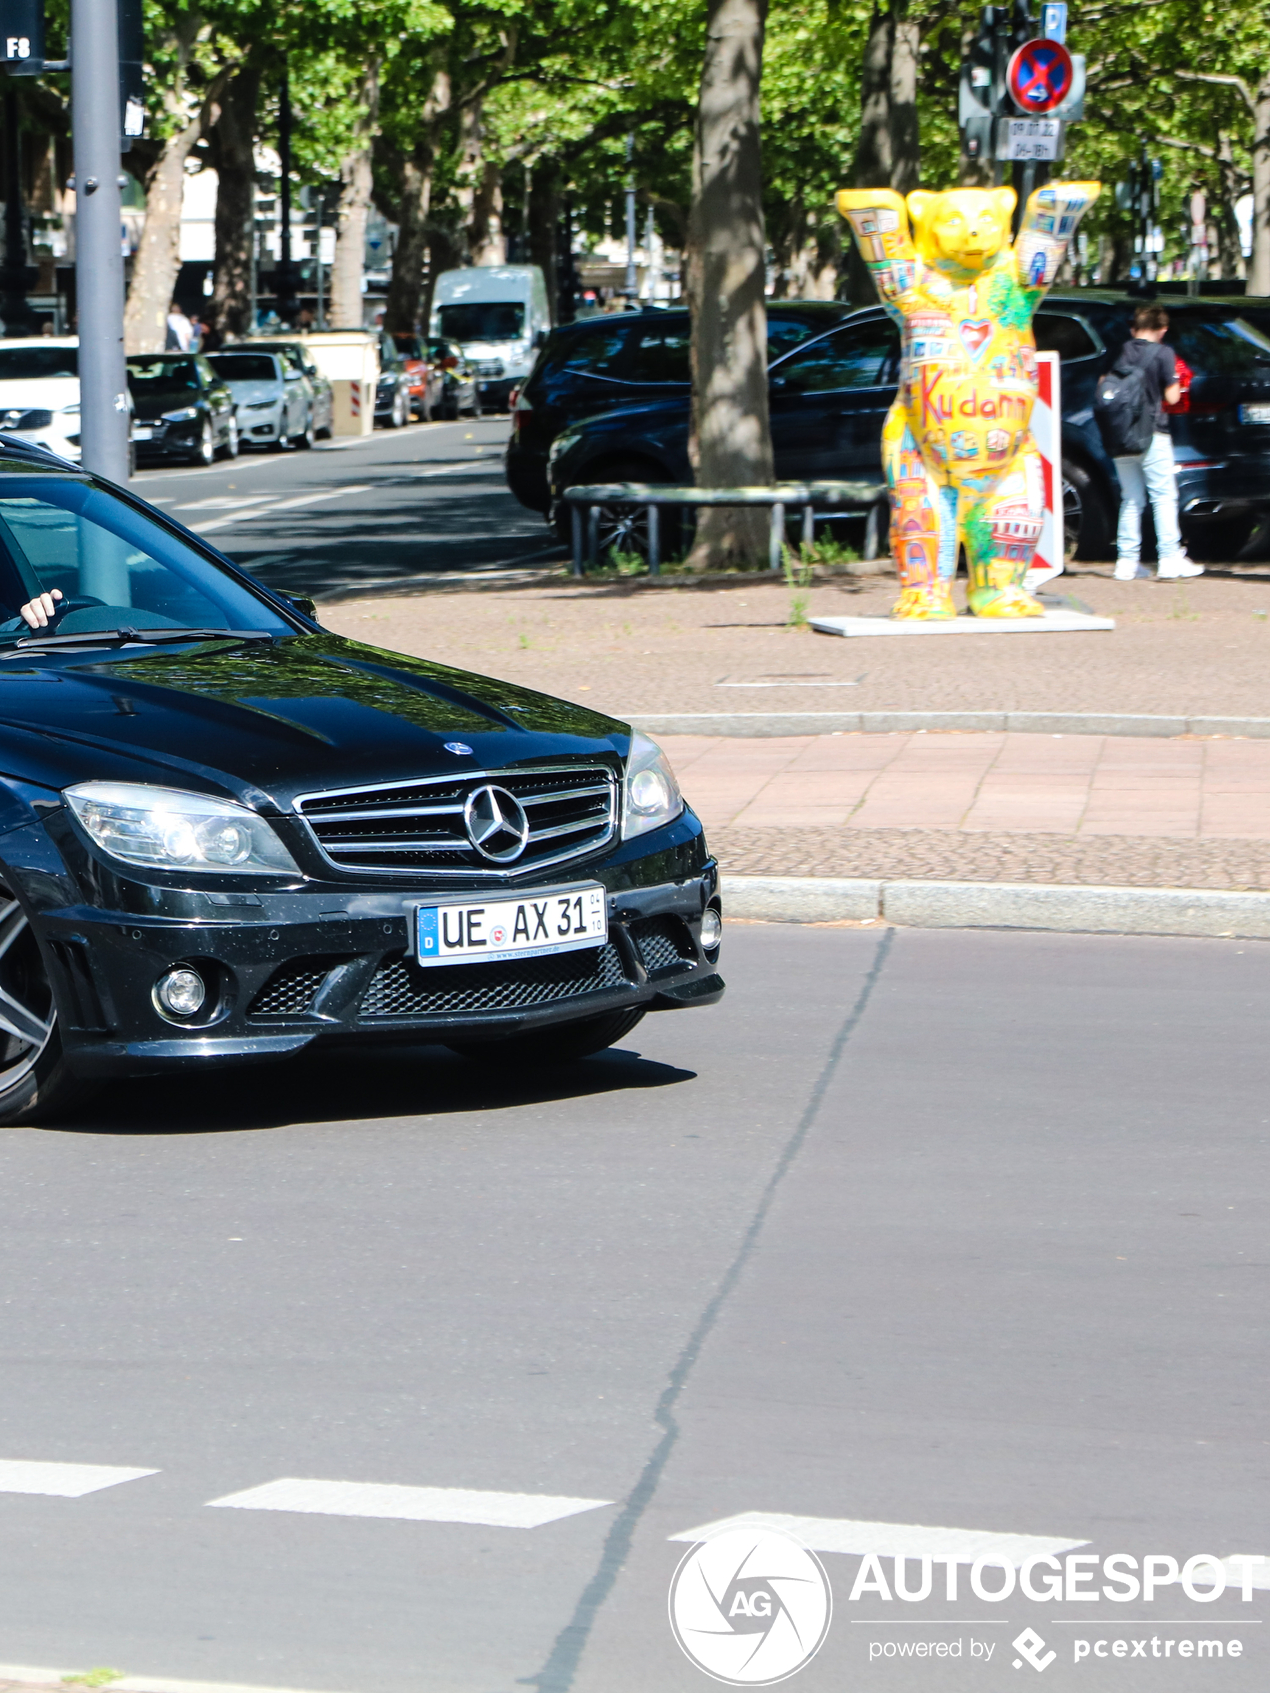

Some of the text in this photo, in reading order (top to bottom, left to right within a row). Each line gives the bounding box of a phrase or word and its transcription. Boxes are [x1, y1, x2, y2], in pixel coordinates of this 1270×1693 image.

[6, 37, 30, 58] F8
[590, 893, 600, 905] 04
[443, 896, 587, 948] UE AX 31
[592, 919, 602, 931] 10
[425, 937, 433, 949] D
[496, 946, 560, 960] www.sternpartner.de
